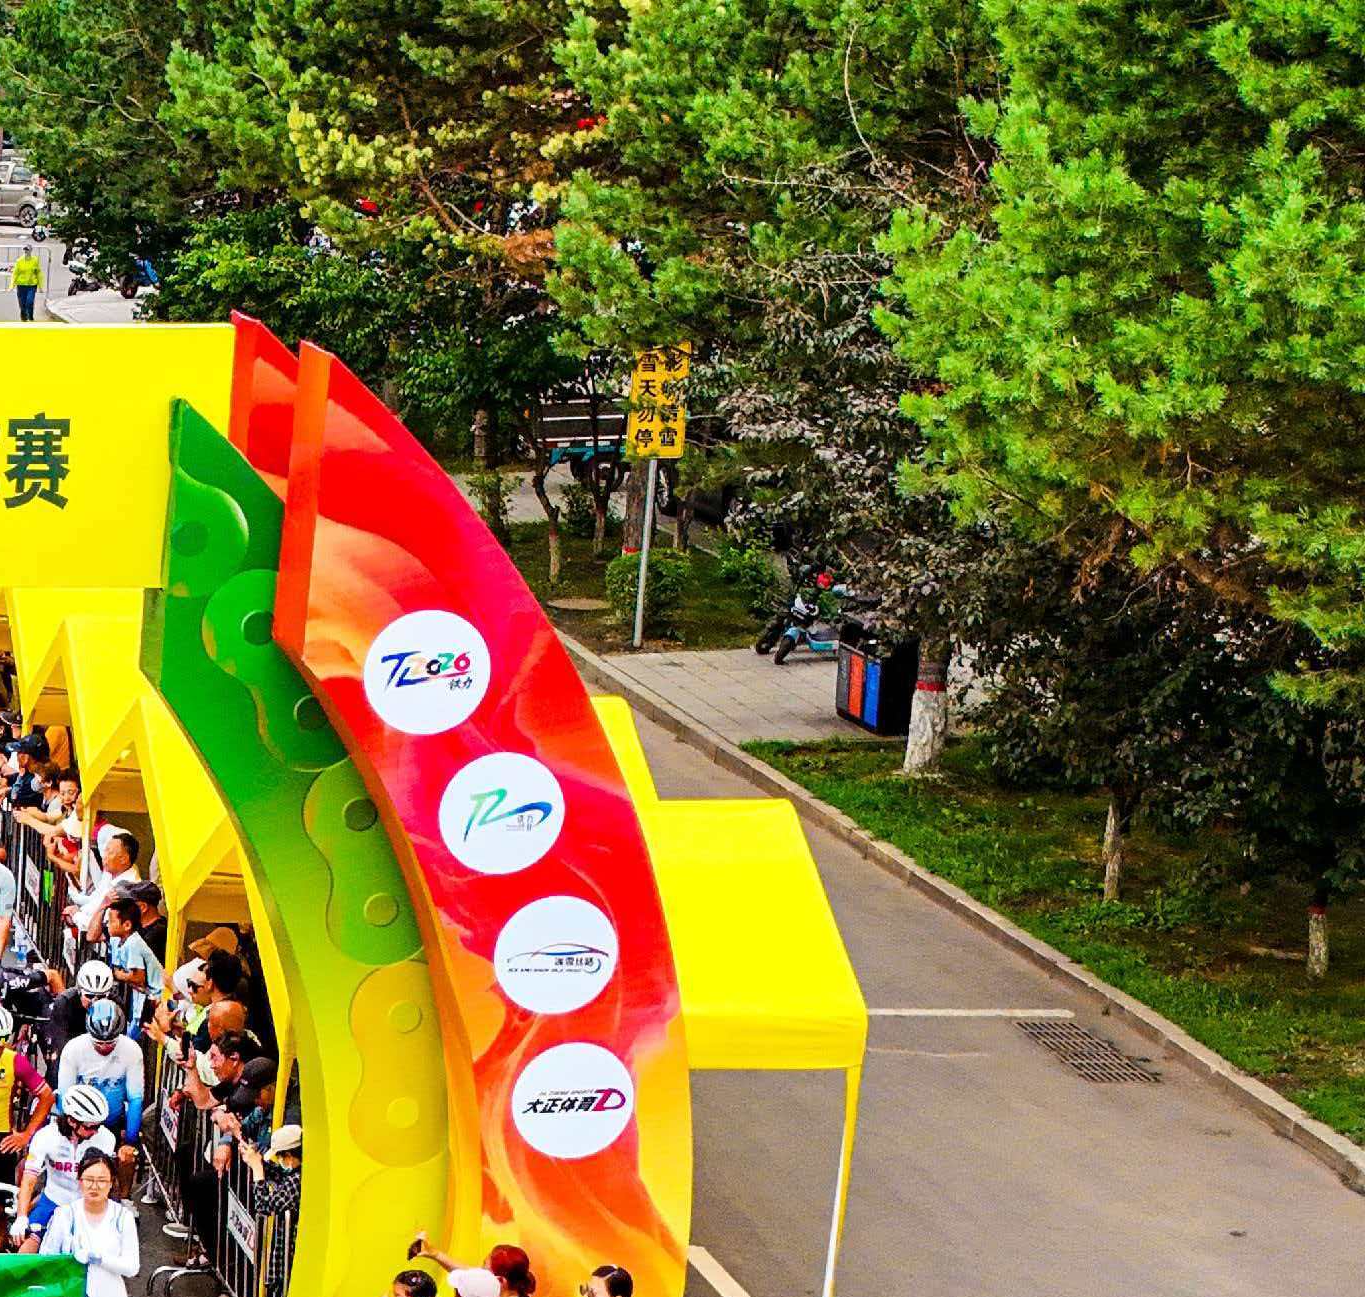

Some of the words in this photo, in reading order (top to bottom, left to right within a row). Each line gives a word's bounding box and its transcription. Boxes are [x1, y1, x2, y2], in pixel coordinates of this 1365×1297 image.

[448, 678, 473, 691] 铁力
[522, 1097, 598, 1114] 大正体育
